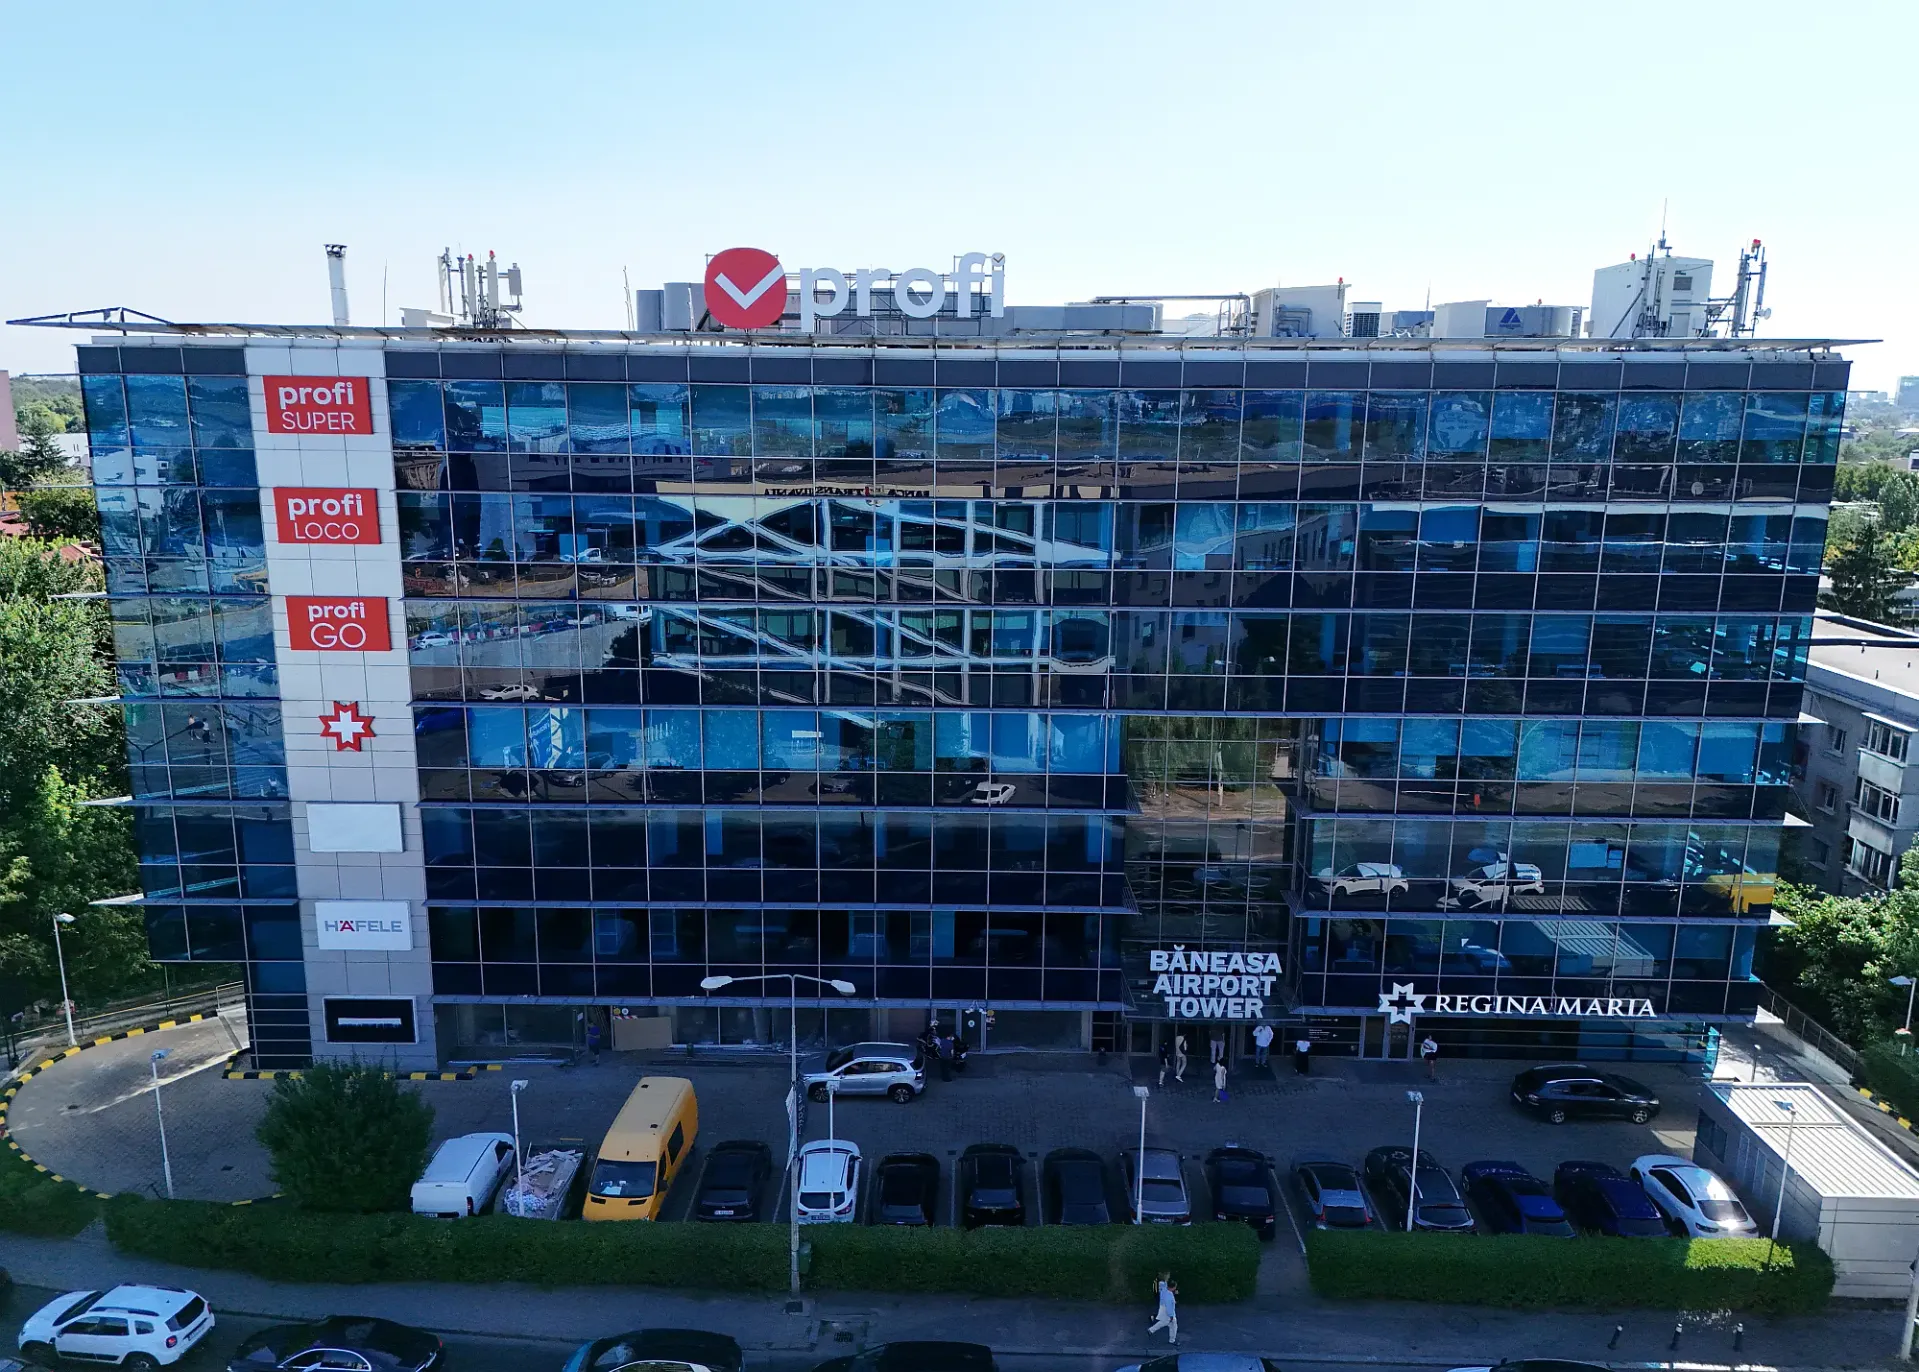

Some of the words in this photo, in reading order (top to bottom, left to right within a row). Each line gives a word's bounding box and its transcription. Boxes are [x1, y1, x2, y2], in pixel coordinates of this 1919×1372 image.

[799, 251, 1006, 333] profi
[278, 381, 354, 410] profi
[282, 411, 356, 431] SUPER
[287, 493, 364, 521] profi
[294, 522, 360, 540] LOCO
[307, 601, 366, 622] profi
[310, 622, 367, 649] GO
[324, 919, 403, 933] HÄFELE
[1150, 944, 1283, 974] BĂNEASA
[1152, 973, 1277, 997] AIRPORT
[1164, 996, 1264, 1019] TOWER
[1433, 994, 1548, 1015] REGINA
[1556, 997, 1658, 1018] MARIA
